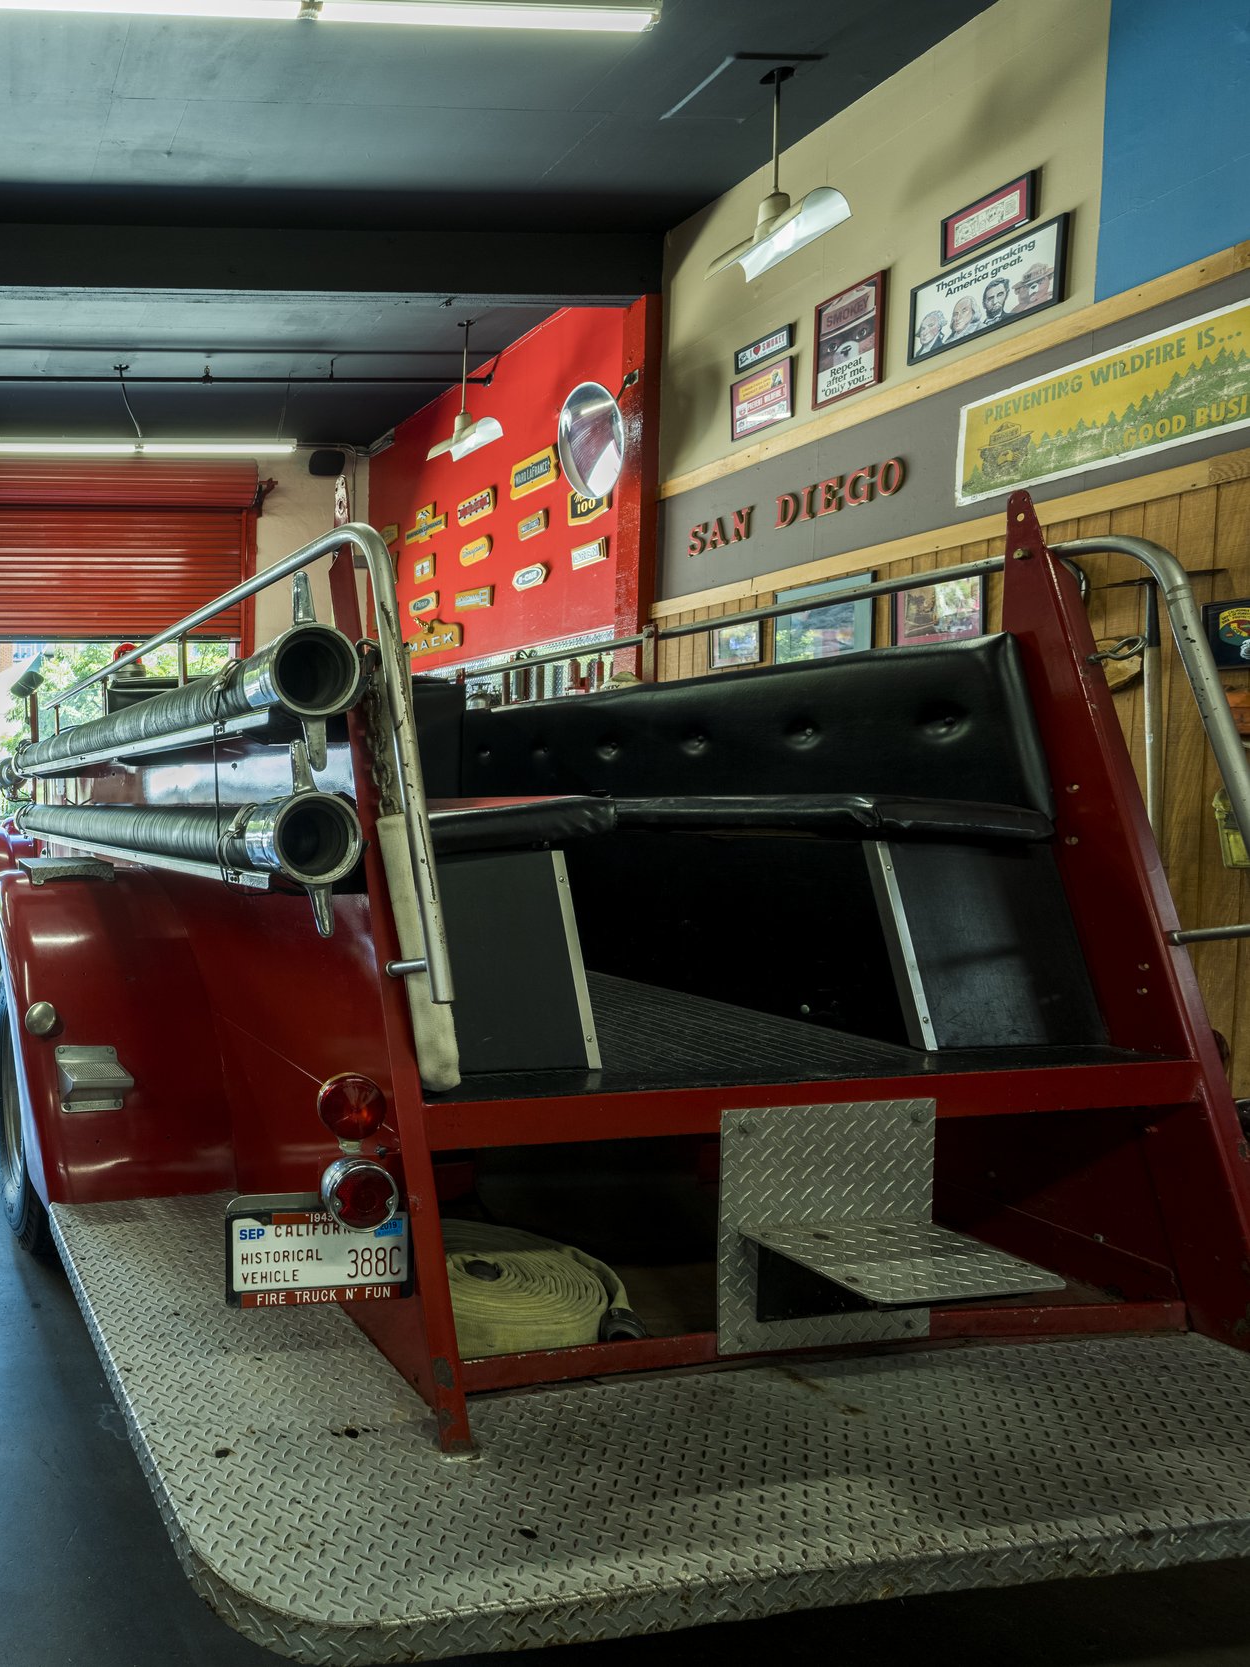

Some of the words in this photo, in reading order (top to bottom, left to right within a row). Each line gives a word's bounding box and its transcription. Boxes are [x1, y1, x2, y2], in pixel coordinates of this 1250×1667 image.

[935, 269, 972, 293] Thanks
[974, 260, 990, 275] for
[991, 240, 1036, 267] making
[945, 272, 989, 298] America
[990, 256, 1023, 279] great.
[826, 295, 869, 328] SMOKEY
[762, 333, 785, 352] SMOKEY
[830, 357, 862, 378] Repeat
[984, 374, 1083, 425] PREVENTING
[1089, 337, 1186, 387] WILDFIRE
[1197, 326, 1242, 350] IS...
[826, 371, 848, 387] after
[1123, 414, 1186, 448] GOOD
[1195, 396, 1247, 427] BUSI
[577, 499, 596, 515] 100
[687, 505, 755, 558] SAN
[774, 457, 906, 530] DIEGO
[409, 632, 453, 652] MACK
[239, 1228, 265, 1241] SEP
[380, 1221, 397, 1230] 2019
[241, 1249, 323, 1265] HISTORICAL
[347, 1246, 402, 1279] 388C
[241, 1269, 299, 1285] VEHICLE
[257, 1292, 287, 1306] FIRE
[294, 1290, 337, 1304] TRUCK
[365, 1286, 391, 1299] FUN
